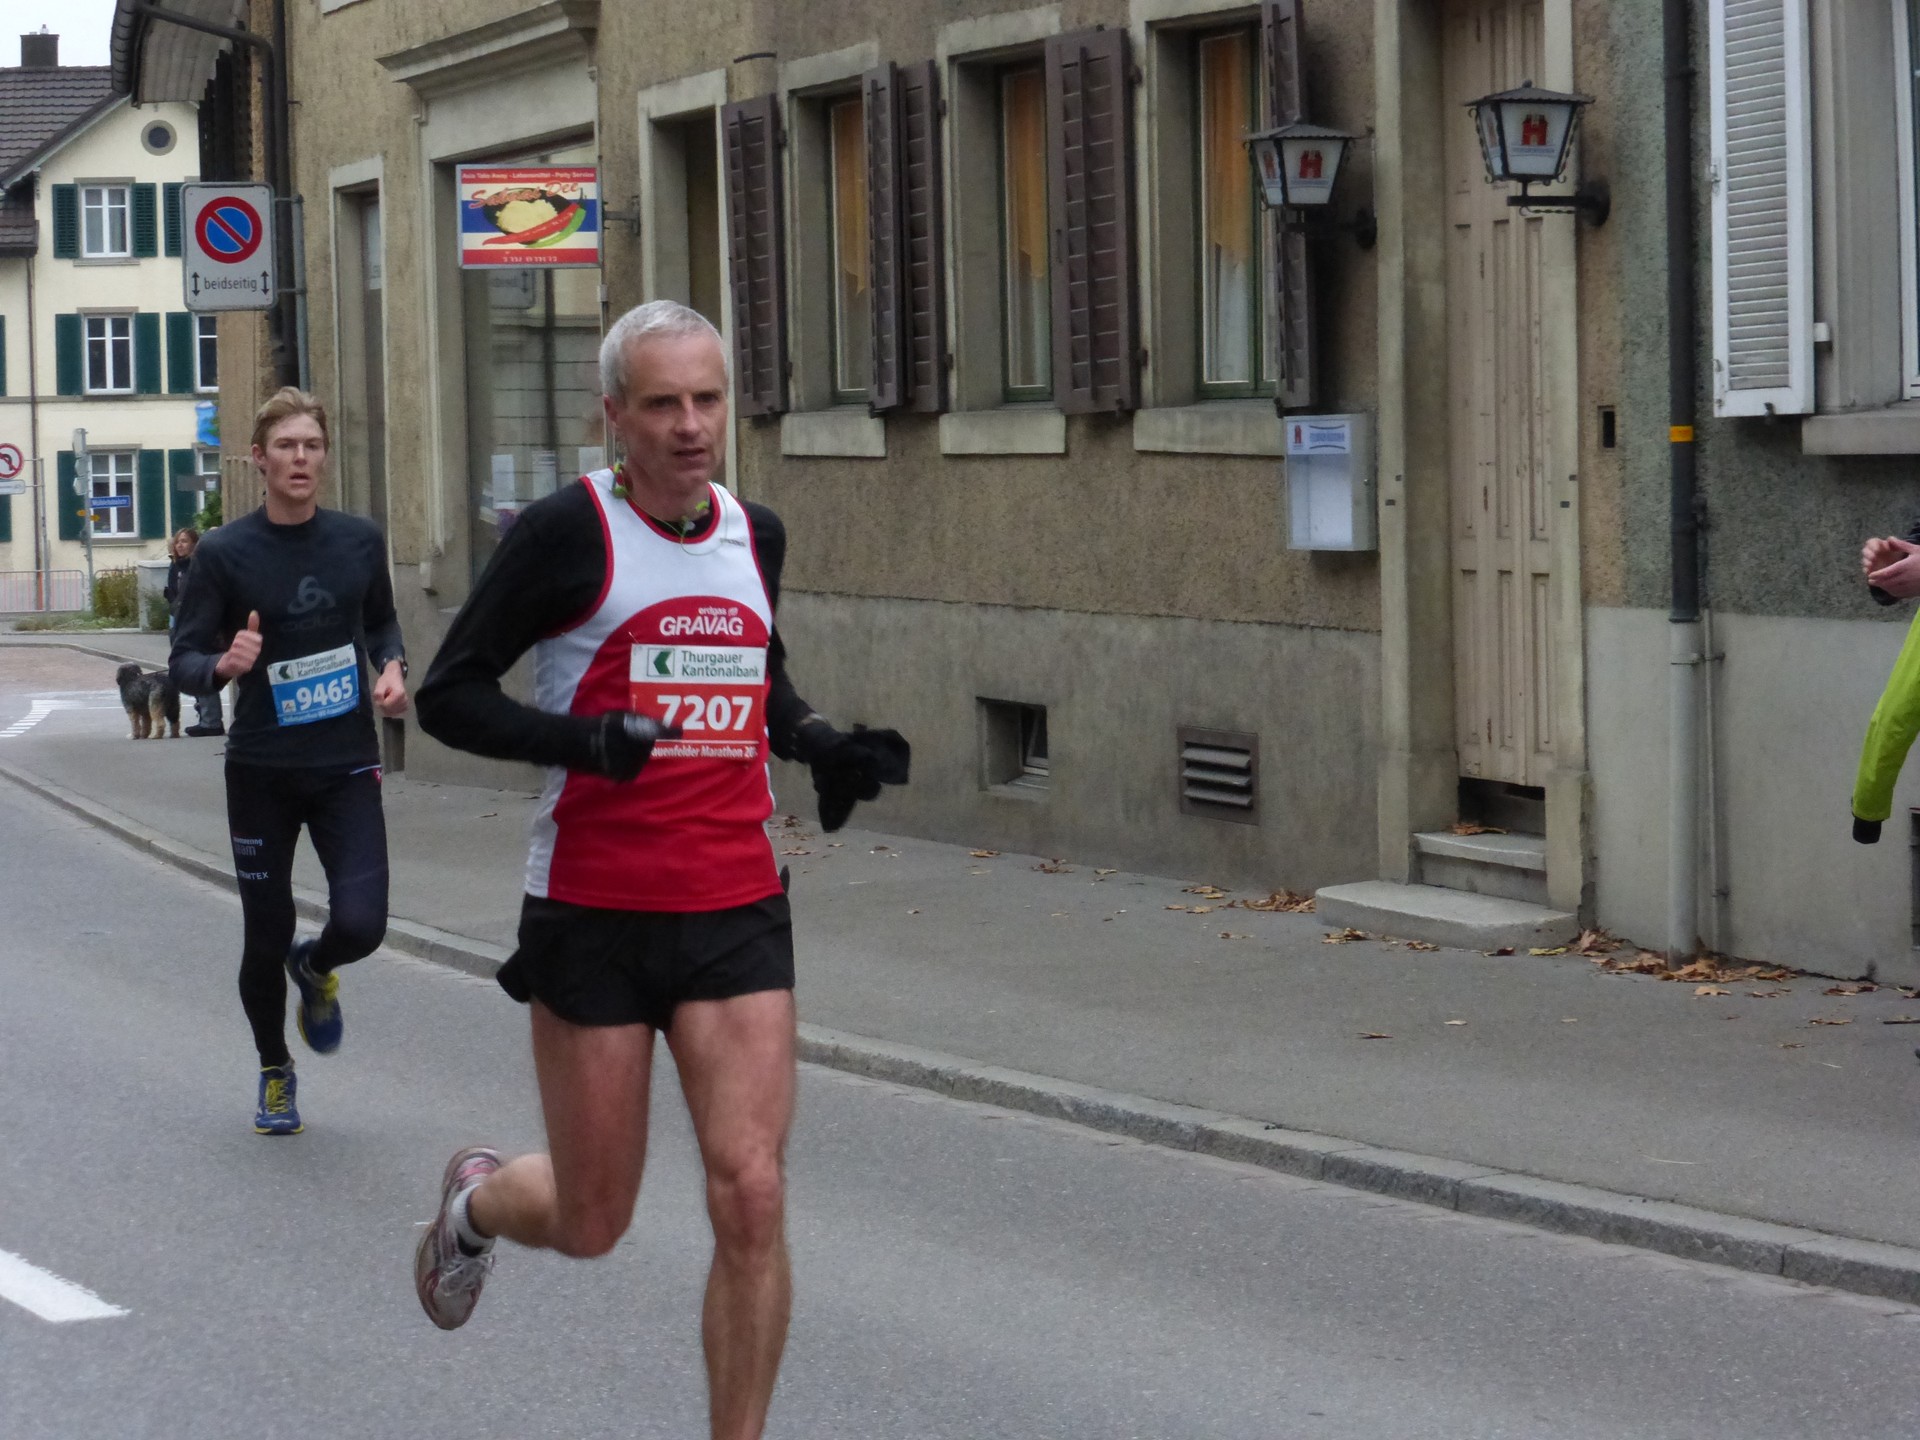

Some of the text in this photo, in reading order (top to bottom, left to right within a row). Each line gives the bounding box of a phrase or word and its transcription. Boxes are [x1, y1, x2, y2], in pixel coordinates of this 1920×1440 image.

[545, 180, 579, 197] Dee
[204, 277, 257, 292] beidseitig
[698, 606, 727, 617] erdgas
[659, 616, 745, 636] GRAVAG
[295, 654, 337, 669] Thurgauer
[681, 650, 743, 665] Thurgauer
[297, 657, 351, 677] Kantonalbank
[681, 664, 759, 678] Kantonalbank
[296, 674, 353, 710] 9465
[657, 694, 753, 731] 7207
[701, 746, 743, 757] Marathon
